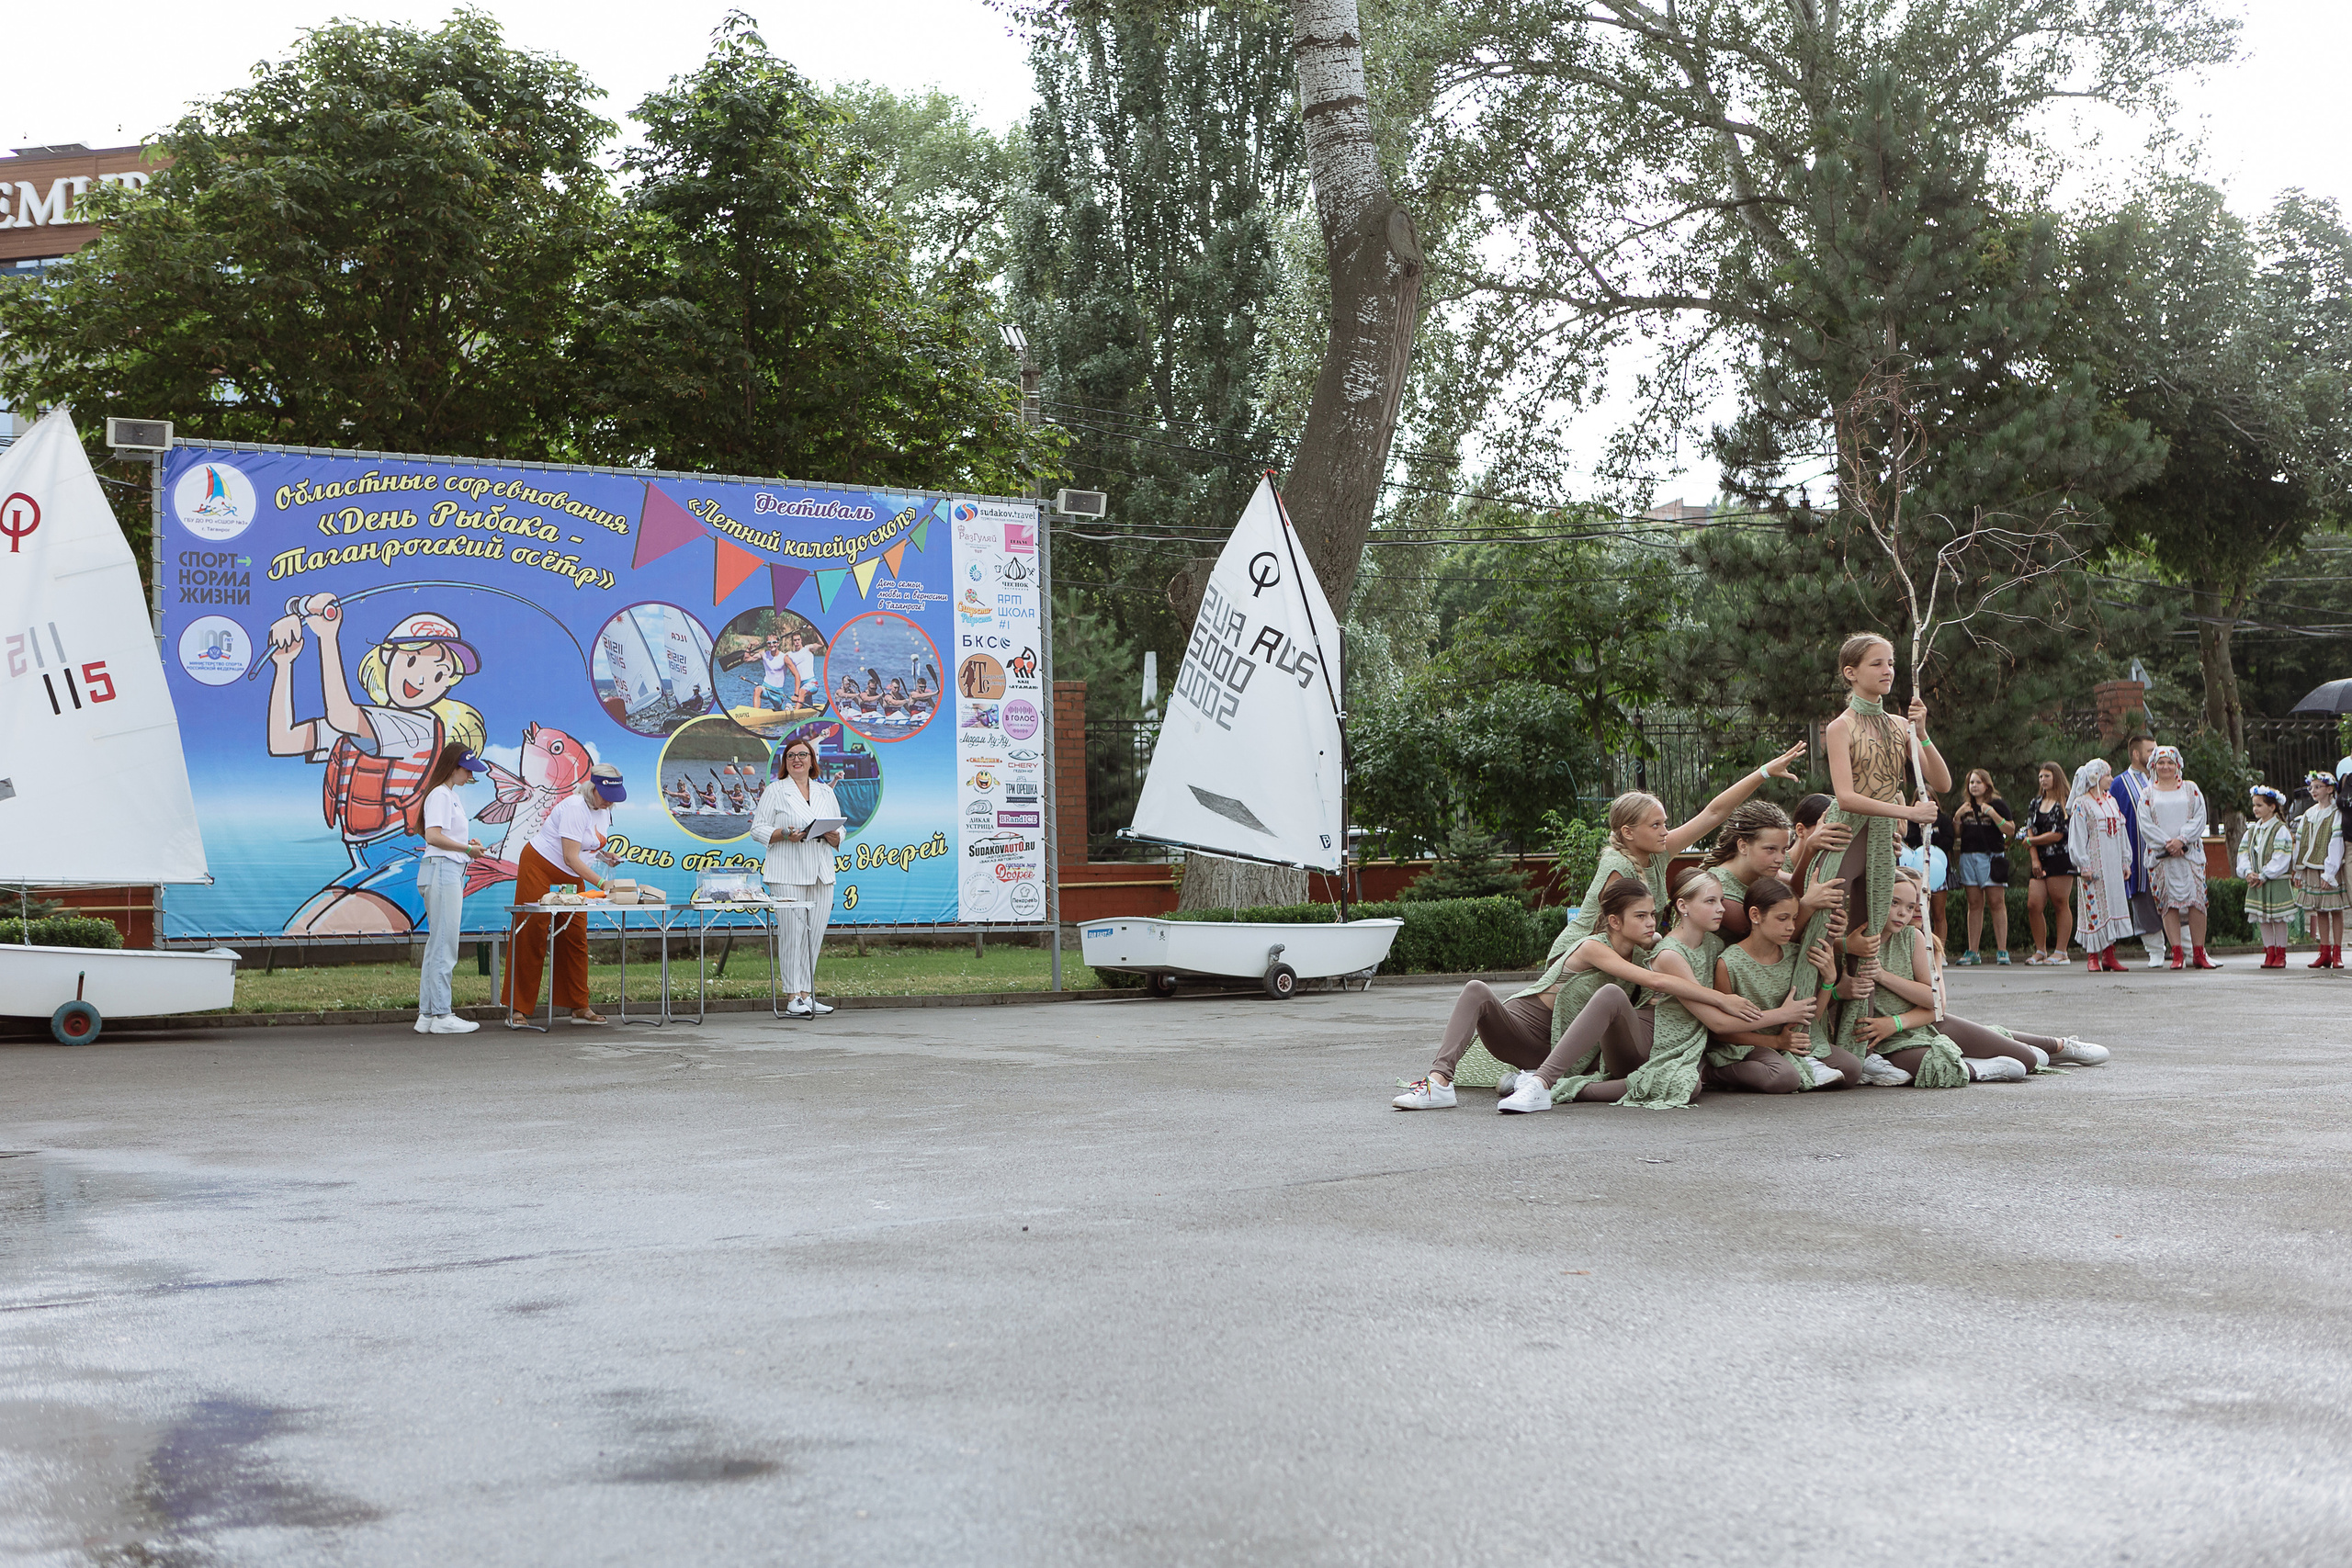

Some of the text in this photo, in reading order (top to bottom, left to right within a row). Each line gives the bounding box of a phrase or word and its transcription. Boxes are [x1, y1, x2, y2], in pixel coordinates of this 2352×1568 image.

[275, 470, 630, 536] Областные соревнования
[753, 491, 876, 522] Фестиваль
[979, 508, 1036, 520] sudakov.travel
[317, 506, 418, 537] «День
[428, 500, 560, 544] Рыбака
[686, 497, 918, 565] «Летний калейдоскоп»
[178, 551, 238, 569] СПОРТ
[266, 533, 616, 591] Таганрогский осётр»
[178, 569, 251, 588] НОРМА
[876, 578, 924, 591] День семьи,
[178, 587, 251, 605] ЖИЗНИ
[877, 589, 948, 603] любви и верности
[877, 599, 926, 614] в Таганроге!
[997, 593, 1022, 604] АРТ
[998, 606, 1035, 618] ШКОЛА
[1188, 621, 1257, 694] 5000
[1249, 625, 1317, 690] RUS
[42, 660, 117, 716] 115
[1005, 783, 1016, 795] ТРИ
[1016, 783, 1038, 795] ОРЕШКА
[606, 834, 675, 869] День
[856, 830, 949, 873] дверей
[843, 885, 859, 910] 3
